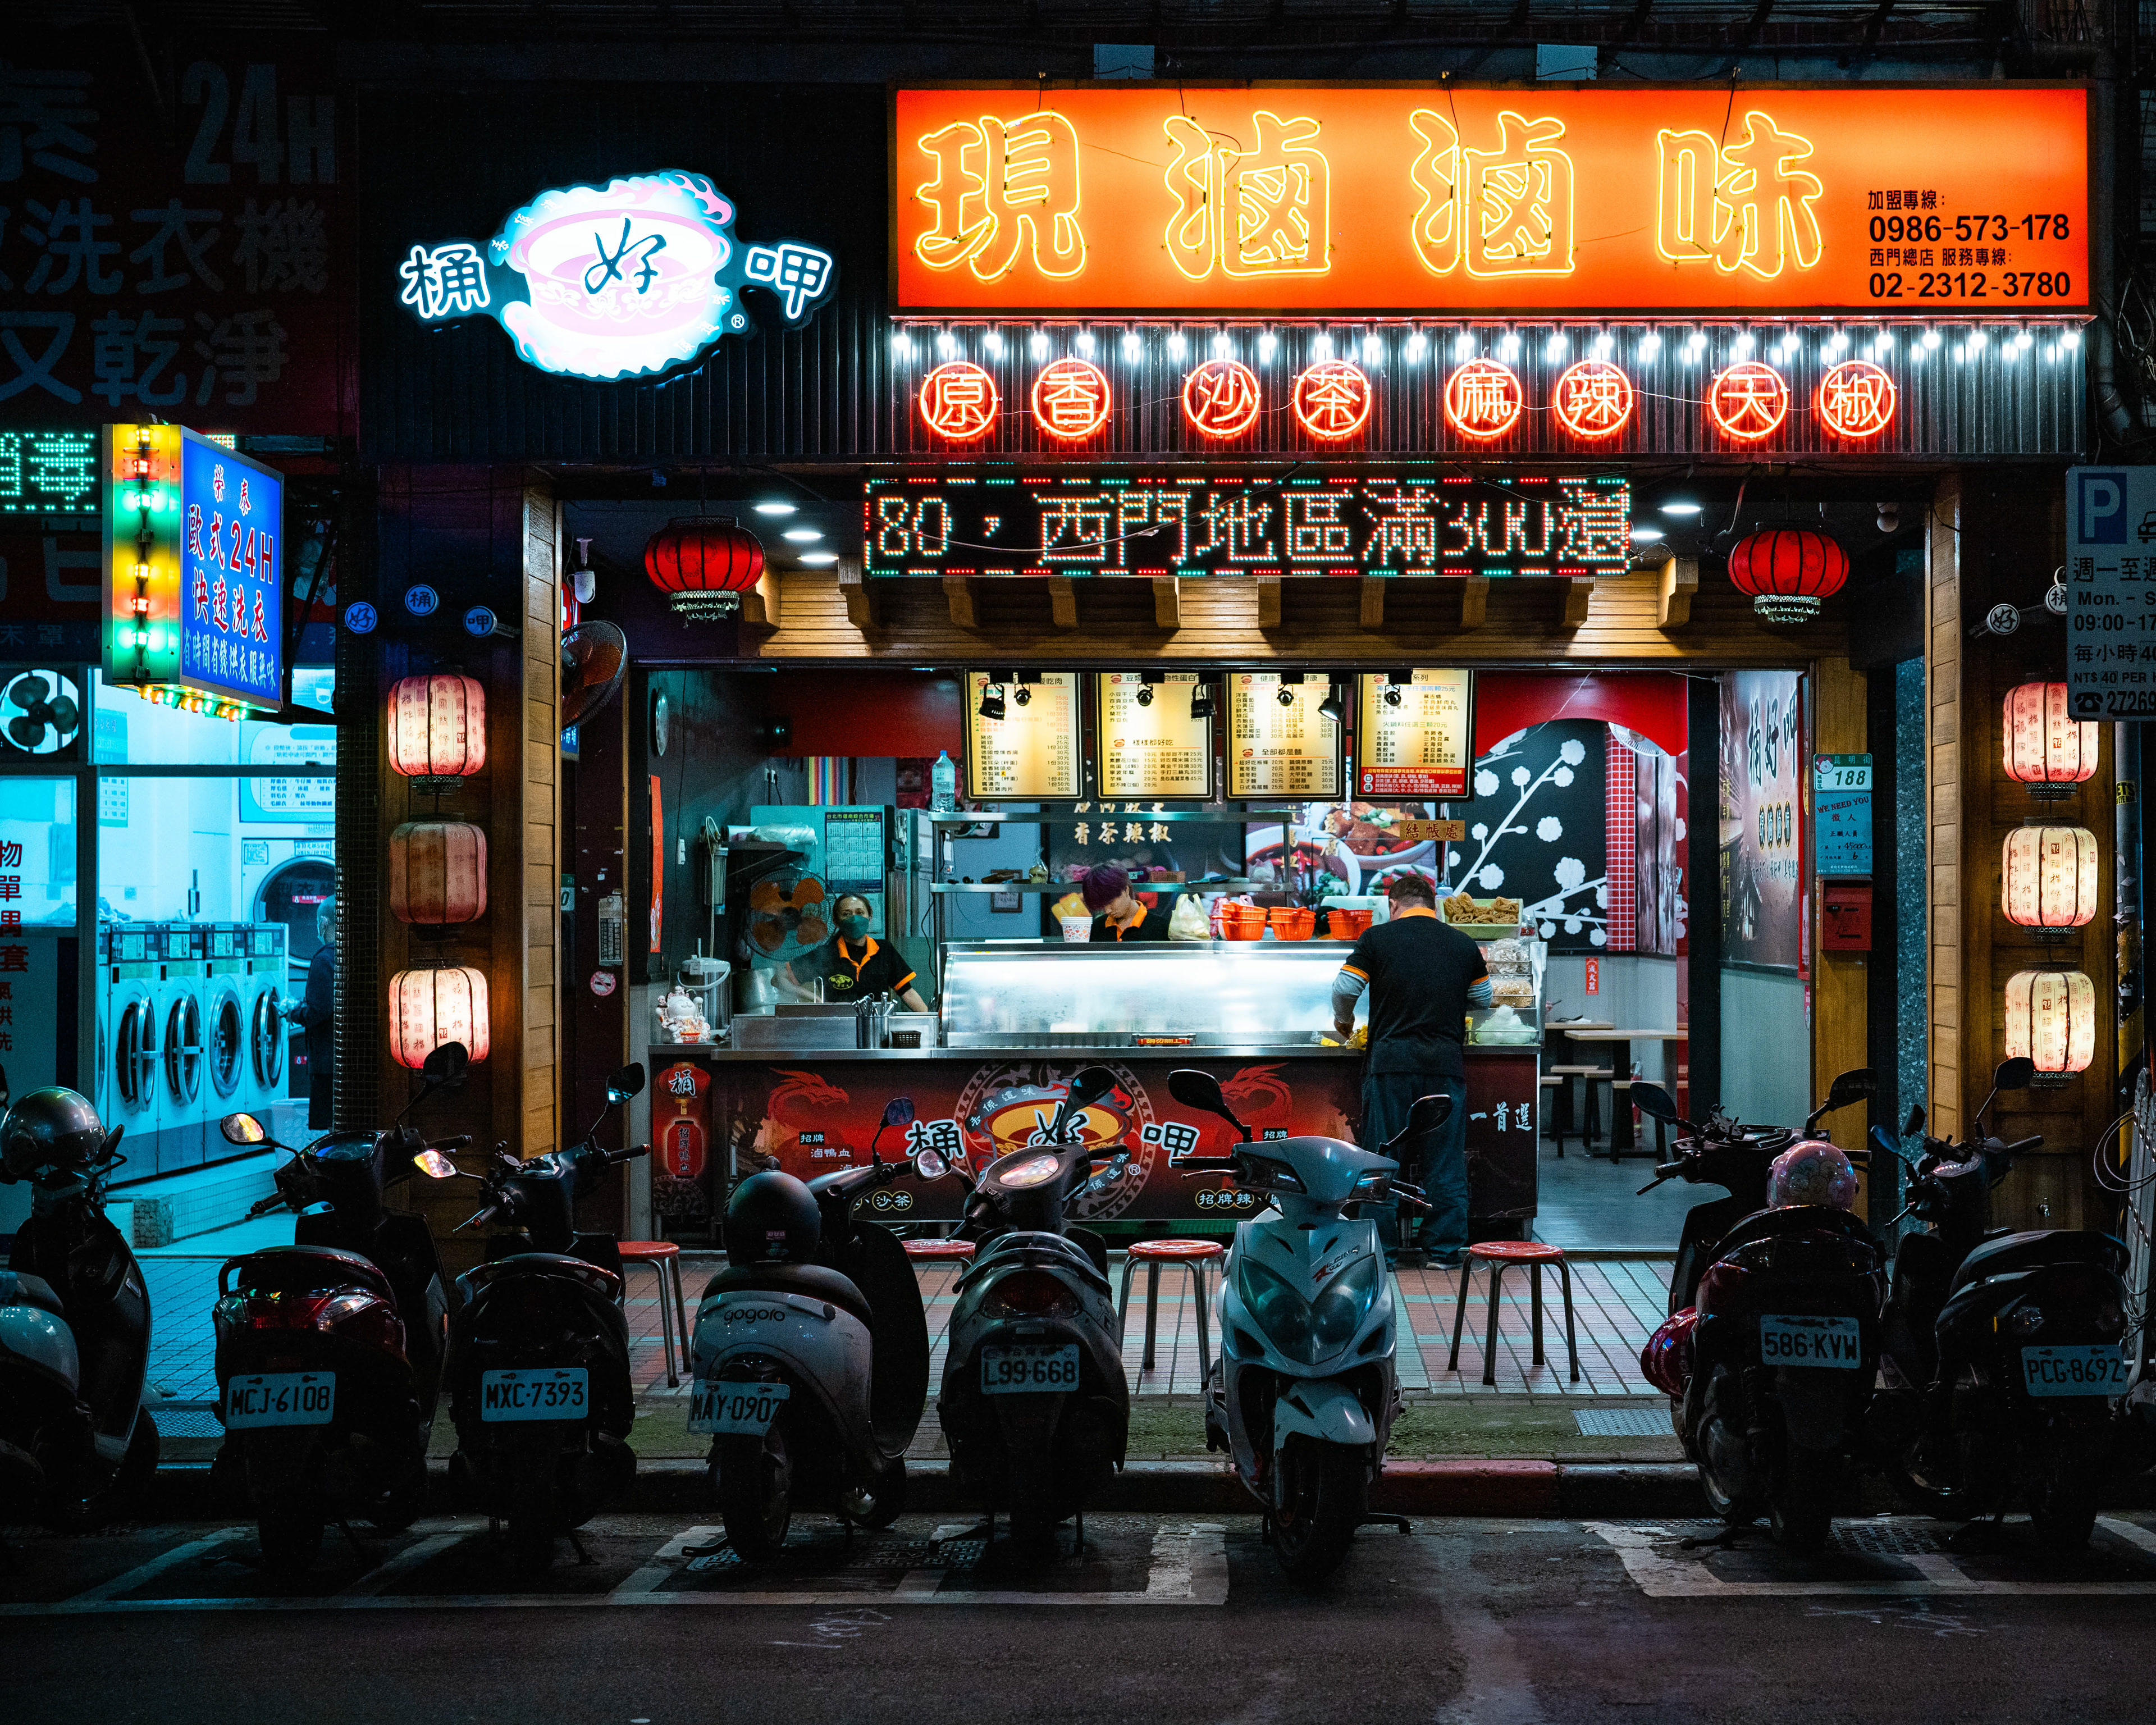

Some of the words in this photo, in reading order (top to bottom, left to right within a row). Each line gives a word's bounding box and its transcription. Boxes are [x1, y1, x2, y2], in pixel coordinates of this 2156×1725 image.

[181, 62, 336, 184] 24H
[1869, 214, 2070, 242] 0986-573-178
[0, 197, 329, 295] 洗衣機
[1870, 248, 1934, 266] 西門總店
[1869, 272, 2071, 298] 02-2312-3780
[2085, 479, 2121, 538] P
[191, 566, 269, 644] 快速洗衣
[2079, 592, 2120, 605] Mon.
[2075, 673, 2098, 683] NT$
[2102, 673, 2117, 683] 40
[2122, 673, 2146, 683] PER
[1834, 756, 1870, 764] 昆明街
[1835, 770, 1866, 786] 188
[1817, 805, 1830, 814] WE
[1831, 801, 1852, 811] NEED
[1853, 796, 1869, 805] YOU
[1405, 823, 1459, 839] 結帳處
[800, 1133, 824, 1143] 招牌
[1264, 1130, 1287, 1139] 招牌
[678, 1128, 691, 1172] 招牌鴨血
[811, 1148, 851, 1158] 滷鴨血
[876, 1195, 910, 1207] 沙茶
[724, 1308, 785, 1324] gogoro
